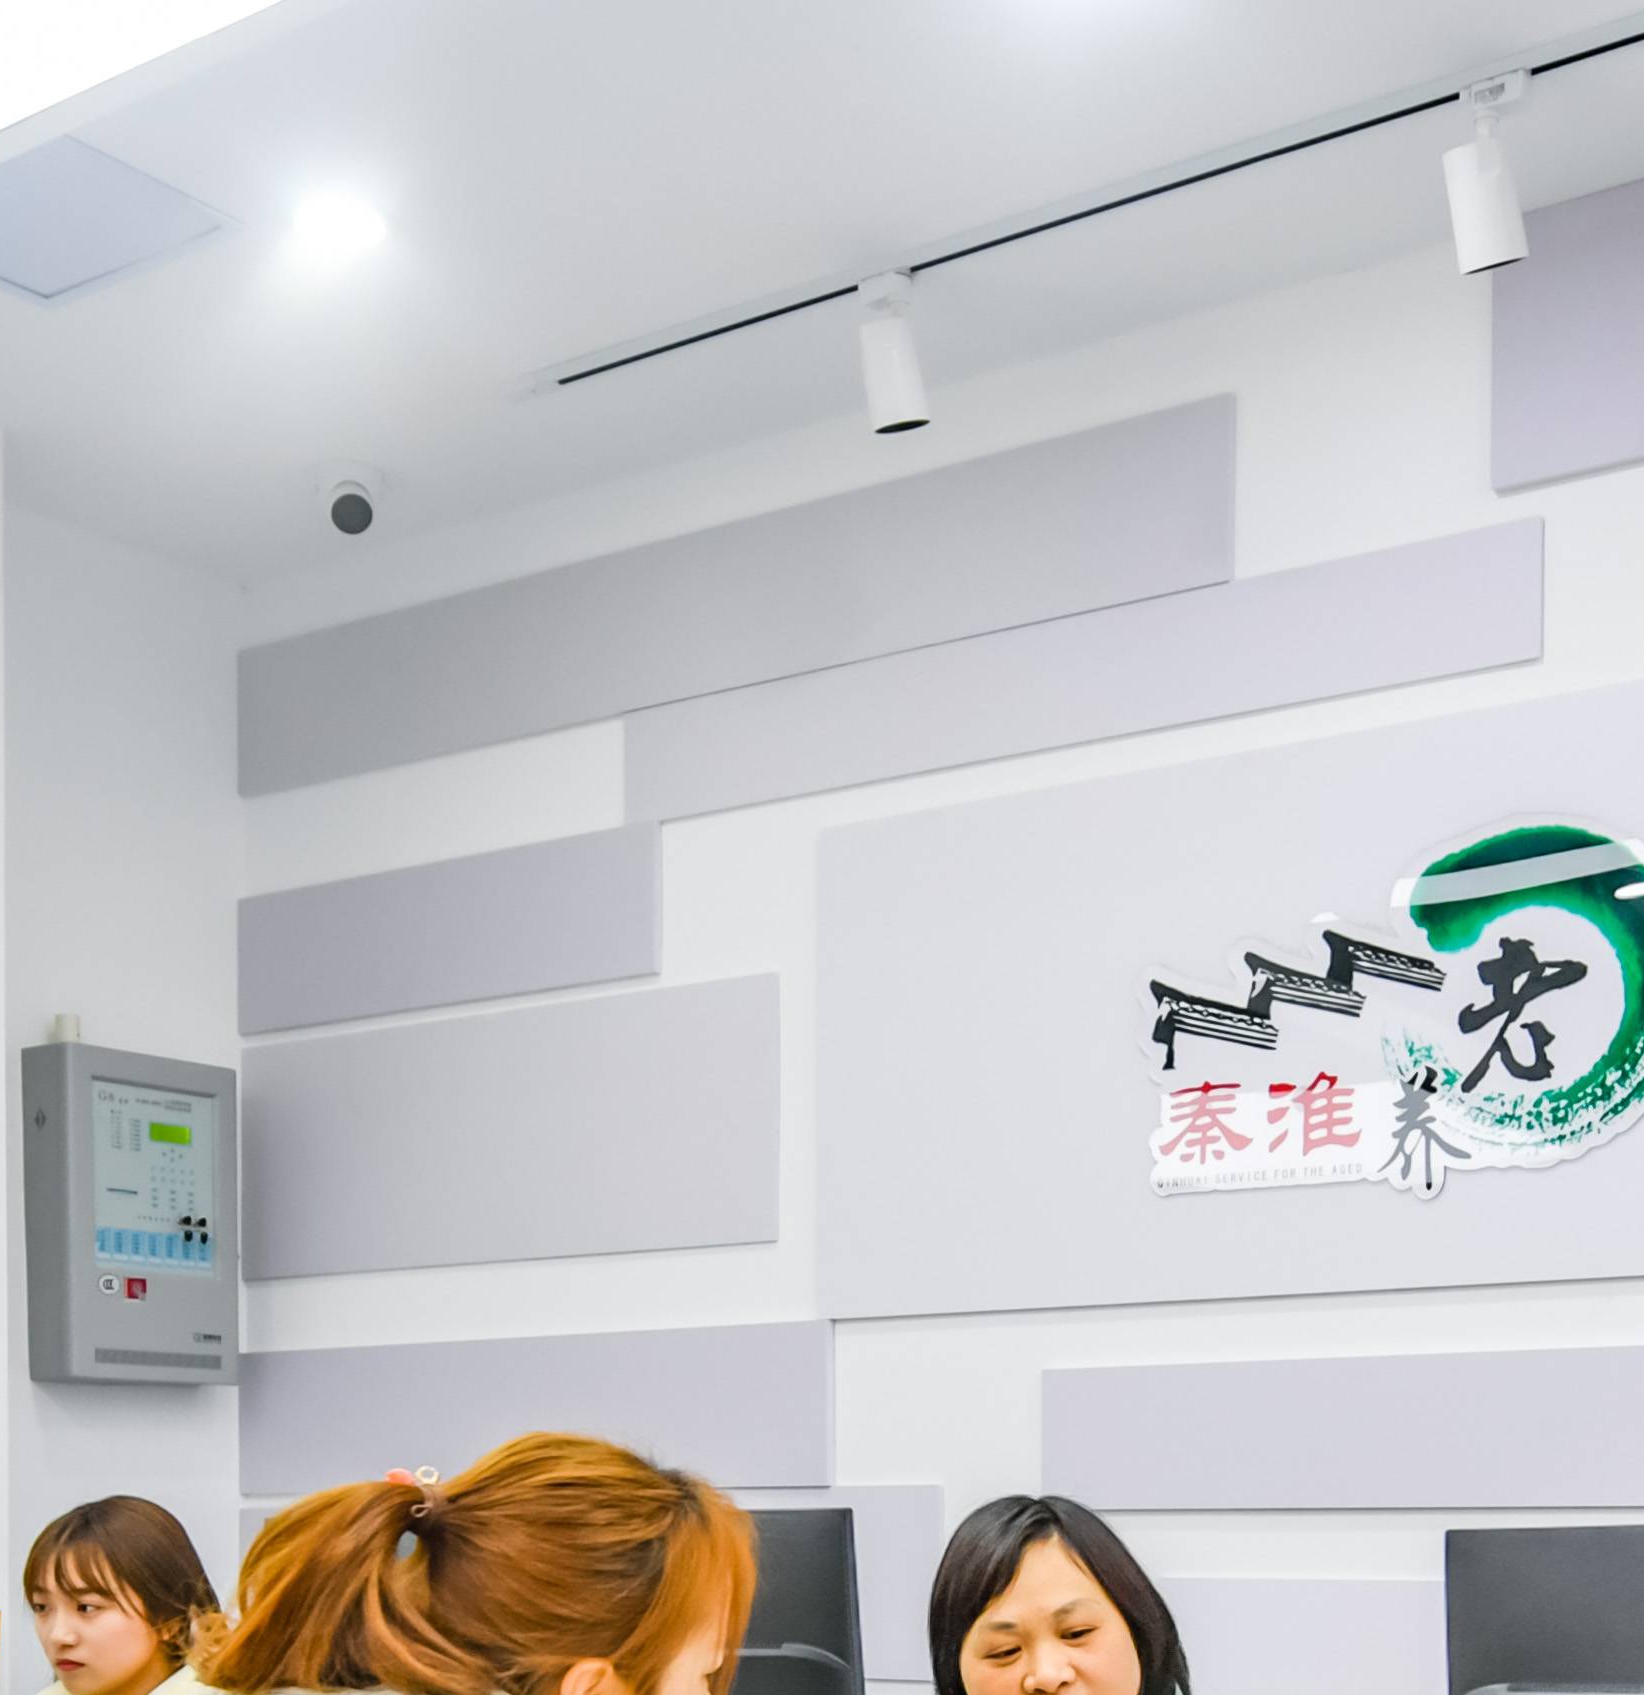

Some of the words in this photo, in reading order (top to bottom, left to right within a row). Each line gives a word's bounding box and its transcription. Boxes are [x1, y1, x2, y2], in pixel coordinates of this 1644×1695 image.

[1215, 1167, 1268, 1184] SERVICE
[1273, 1167, 1297, 1182] FOR
[1303, 1164, 1325, 1178] THE
[1331, 1162, 1364, 1176] AGED
